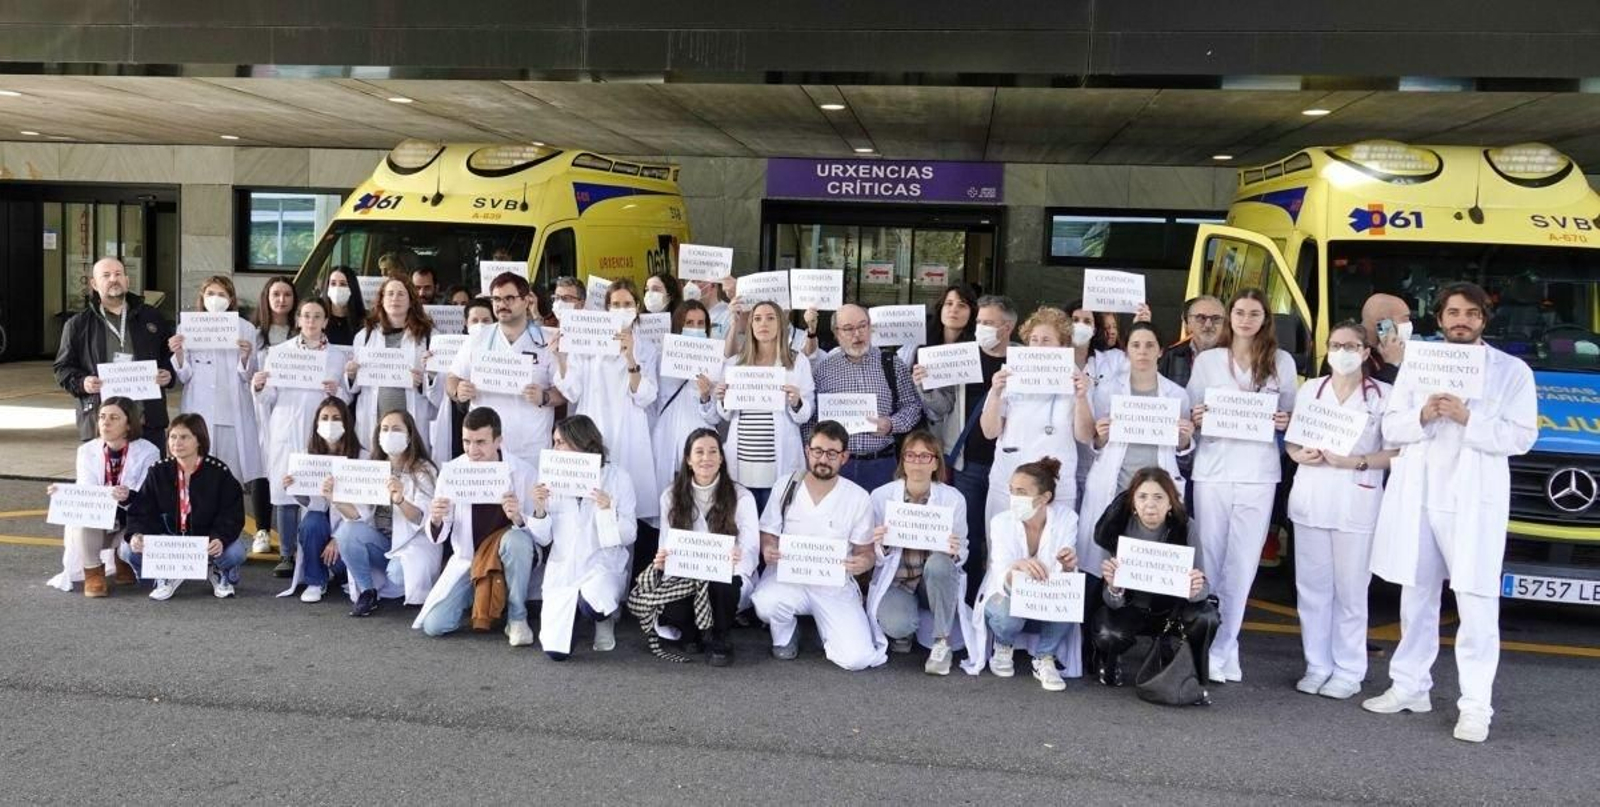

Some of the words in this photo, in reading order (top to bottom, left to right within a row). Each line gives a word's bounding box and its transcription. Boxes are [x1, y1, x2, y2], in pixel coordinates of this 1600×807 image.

[816, 164, 934, 179] URXENCIAS
[827, 179, 921, 196] CRÍTICAS
[368, 195, 404, 210] 061
[473, 198, 519, 210] SVB
[1370, 210, 1424, 229] 061
[1530, 214, 1592, 231] SVB
[1549, 233, 1588, 243] A-670
[683, 259, 729, 270] SEGUIMIENTO
[711, 270, 720, 278] XA
[1087, 285, 1142, 297] SEGUIMIENTO
[1096, 298, 1116, 306] MUH
[1120, 299, 1133, 307] XA
[564, 326, 618, 336] SEGUIMIENTO
[872, 320, 923, 330] SEGUIMIENTO
[879, 331, 897, 339] MUH
[571, 339, 590, 347] MUH
[597, 340, 608, 348] XA
[666, 350, 721, 364] SEGUIMIENTO
[270, 362, 324, 372] SEGUIMIENTO
[360, 361, 410, 370] SEGUIMIENTO
[672, 363, 692, 372] MUH
[698, 366, 709, 374] XA
[1009, 364, 1071, 373] SEGUIMIENTO
[1407, 361, 1480, 375] SEGUIMIENTO
[279, 372, 297, 381] MUH
[369, 372, 386, 380] MUH
[474, 366, 529, 378] SEGUIMIENTO
[932, 371, 952, 380] MUH
[483, 378, 501, 386] MUH
[508, 380, 518, 388] XA
[1020, 377, 1041, 385] MUH
[1047, 377, 1060, 385] XA
[1418, 376, 1441, 386] MUH
[1449, 378, 1464, 389] XA
[736, 395, 756, 403] MUH
[761, 395, 773, 403] XA
[1114, 412, 1177, 425] SEGUIMIENTO
[1208, 407, 1273, 420] SEGUIMIENTO
[1216, 420, 1239, 430] MUH
[1246, 422, 1258, 432] XA
[1296, 412, 1358, 438] SEGUIMIENTO
[1123, 426, 1145, 435] MUH
[1152, 428, 1164, 437] XA
[1302, 429, 1324, 441] MUH
[1331, 437, 1342, 446] XA
[543, 467, 597, 481] SEGUIMIENTO
[445, 478, 506, 487] SEGUIMIENTO
[550, 481, 570, 490] MUH
[575, 482, 587, 491] XA
[369, 489, 379, 497] XA
[455, 490, 476, 498] MUH
[483, 490, 494, 498] XA
[55, 498, 113, 510] SEGUIMIENTO
[62, 510, 83, 520] MUH
[90, 512, 101, 521] XA
[888, 518, 949, 532] SEGUIMIENTO
[897, 532, 918, 542] MUH
[925, 534, 937, 544] XA
[146, 551, 206, 561] SEGUIMIENTO
[669, 549, 731, 563] SEGUIMIENTO
[782, 552, 842, 566] SEGUIMIENTO
[155, 563, 176, 572] MUH
[181, 564, 194, 572] XA
[678, 561, 699, 572] MUH
[706, 564, 718, 575] XA
[1120, 556, 1188, 575] SEGUIMIENTO
[791, 567, 812, 577] MUH
[819, 569, 831, 577] XA
[1129, 571, 1154, 583] MUH
[1161, 575, 1174, 587] XA
[1016, 588, 1081, 600] SEGUIMIENTO
[1518, 578, 1572, 599] 5757
[1025, 602, 1048, 612] MUH
[1055, 604, 1068, 614] XA
